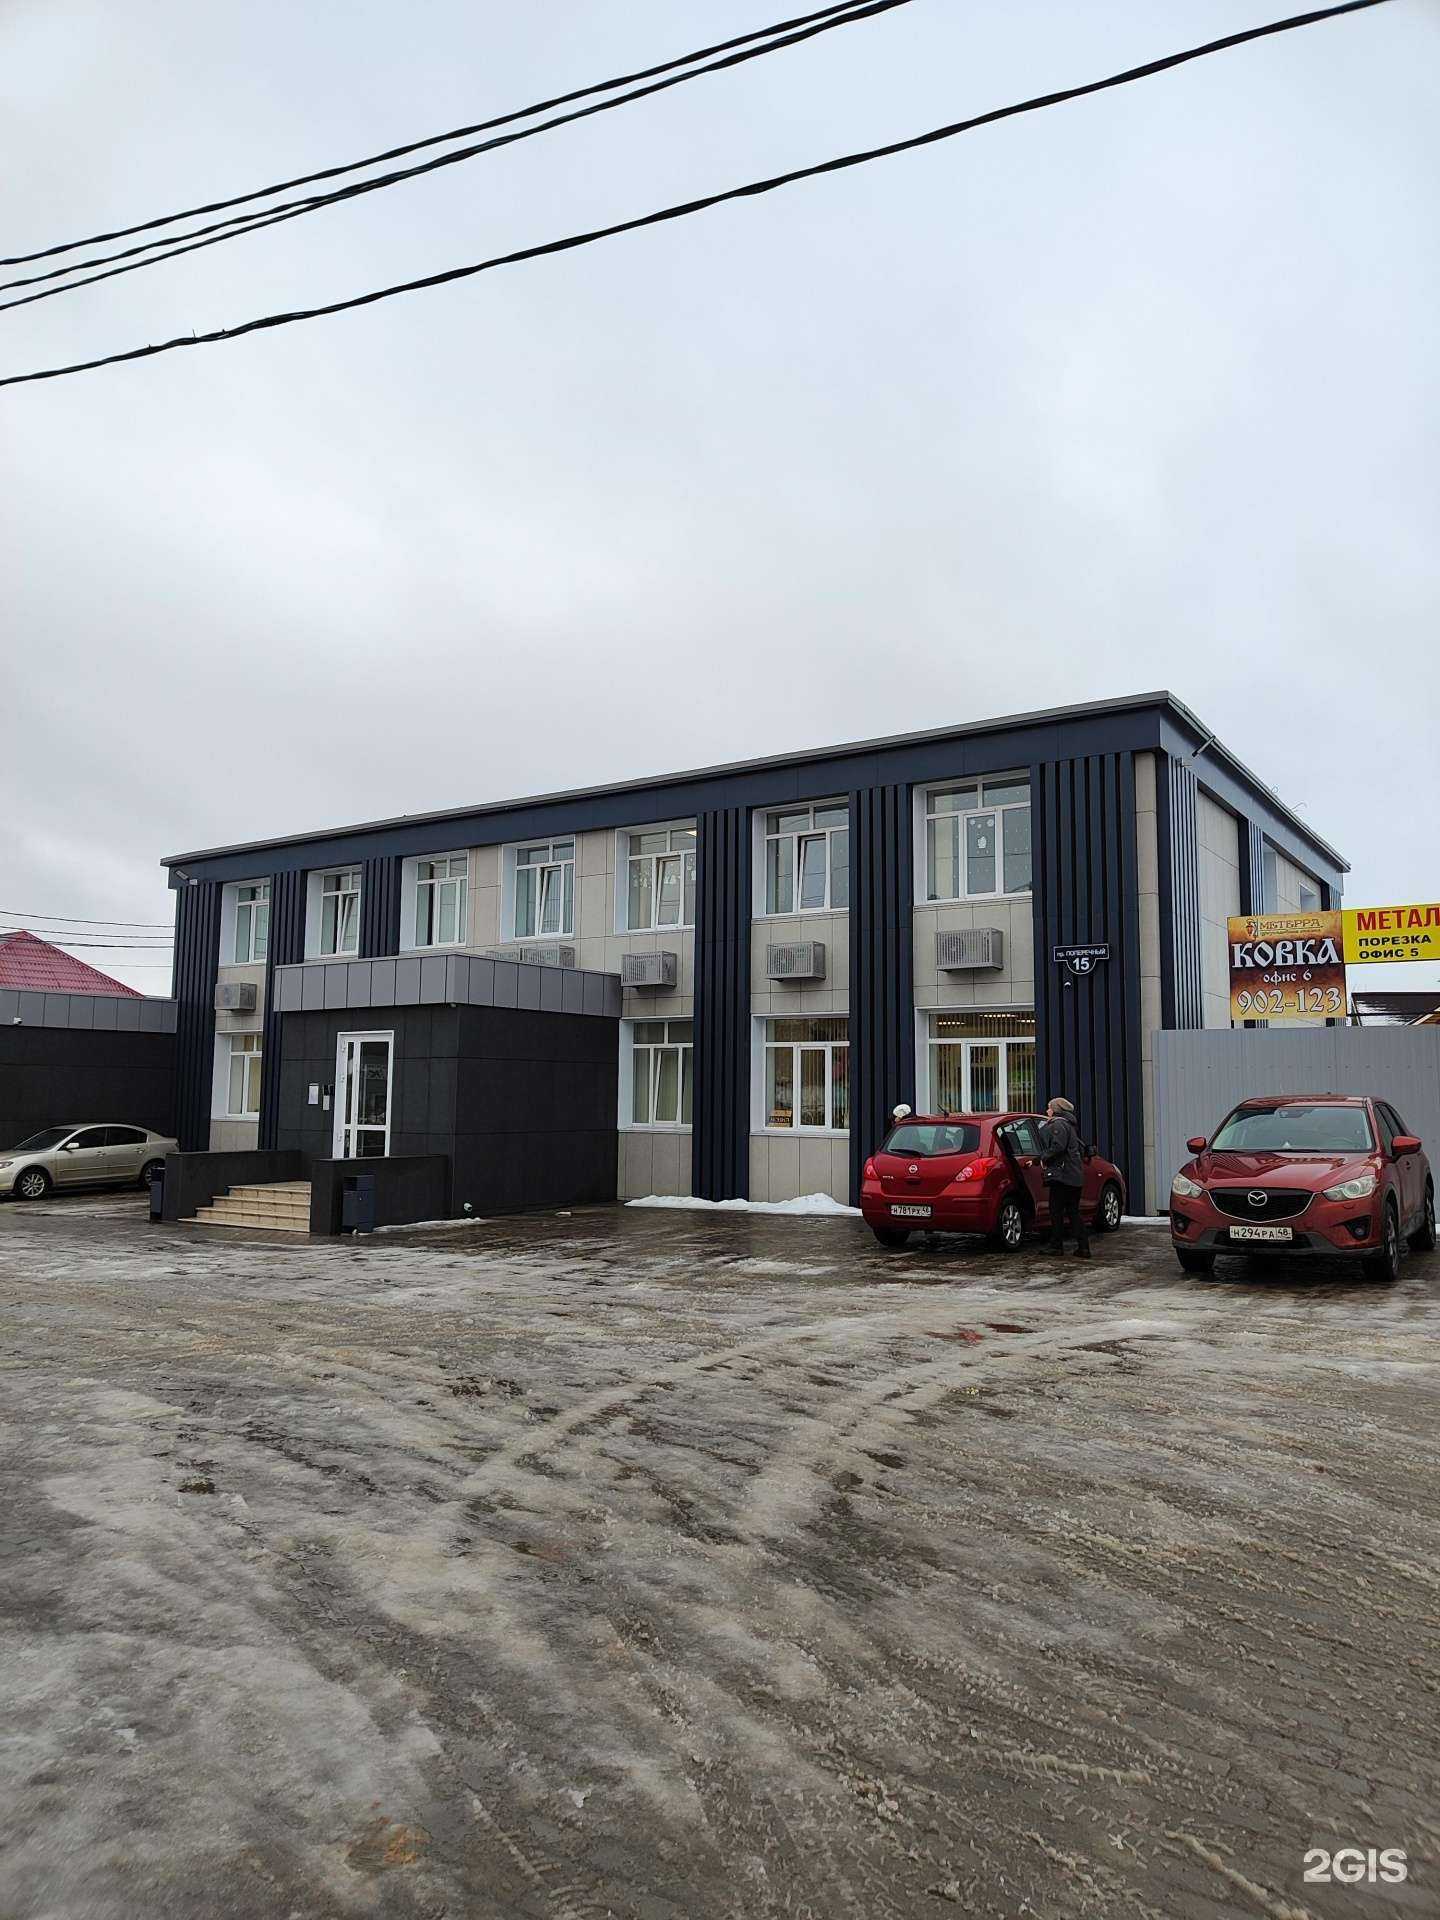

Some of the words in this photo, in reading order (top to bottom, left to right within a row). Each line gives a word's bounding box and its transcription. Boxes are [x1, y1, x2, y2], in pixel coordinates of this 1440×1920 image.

[1357, 907, 1440, 931] МЕТАЛ
[1359, 935, 1431, 946] ПОРЕЗКА
[1231, 938, 1342, 968] КОВКА
[1359, 949, 1404, 959] ОФИС
[1411, 948, 1419, 956] 5
[1073, 957, 1090, 970] 15
[1263, 971, 1296, 985] офис
[1303, 969, 1312, 981] 6
[1237, 987, 1342, 1015] 902-123
